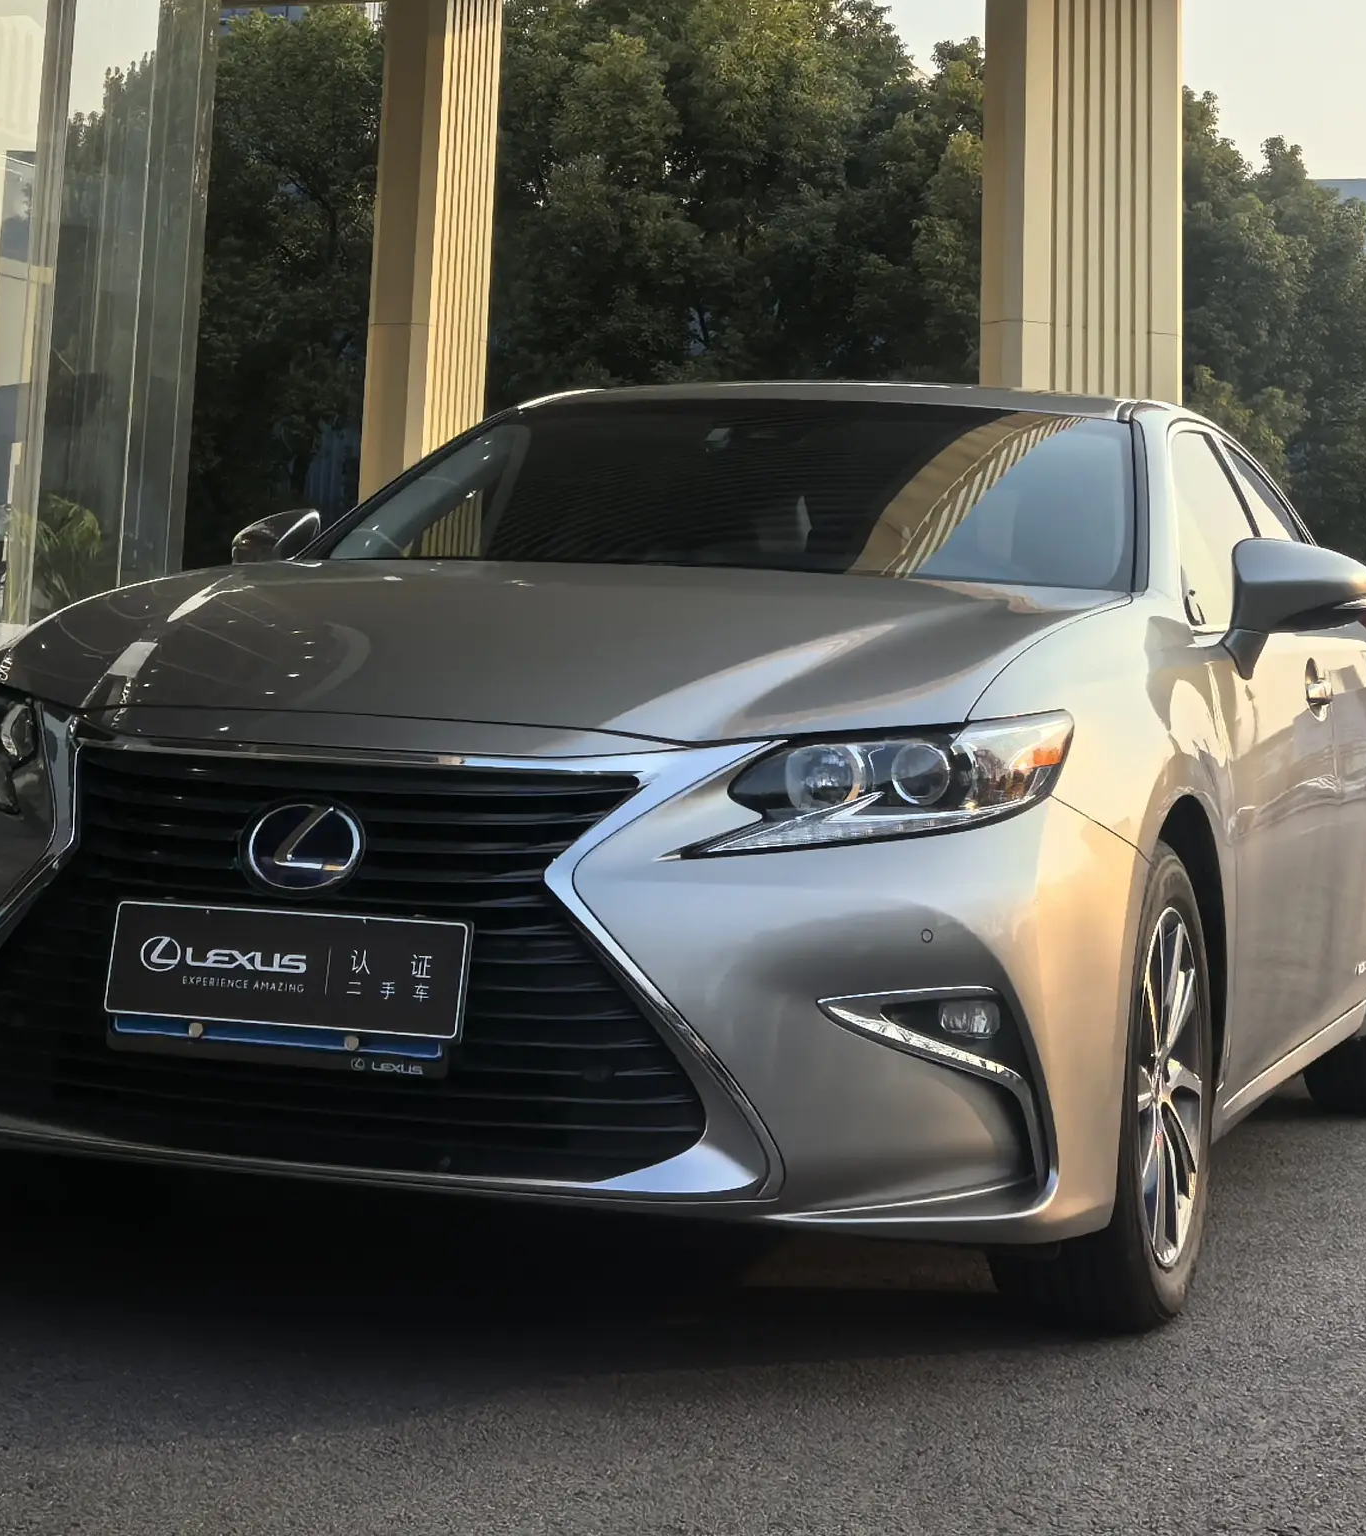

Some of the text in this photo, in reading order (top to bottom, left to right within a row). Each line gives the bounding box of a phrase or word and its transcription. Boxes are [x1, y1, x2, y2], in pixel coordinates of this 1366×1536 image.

[185, 946, 307, 974] LEXUS
[350, 949, 433, 980] 认证
[182, 975, 305, 994] EXPERIENCE AMAZING
[346, 981, 429, 1002] 二手车
[371, 1060, 424, 1076] LEXUS
